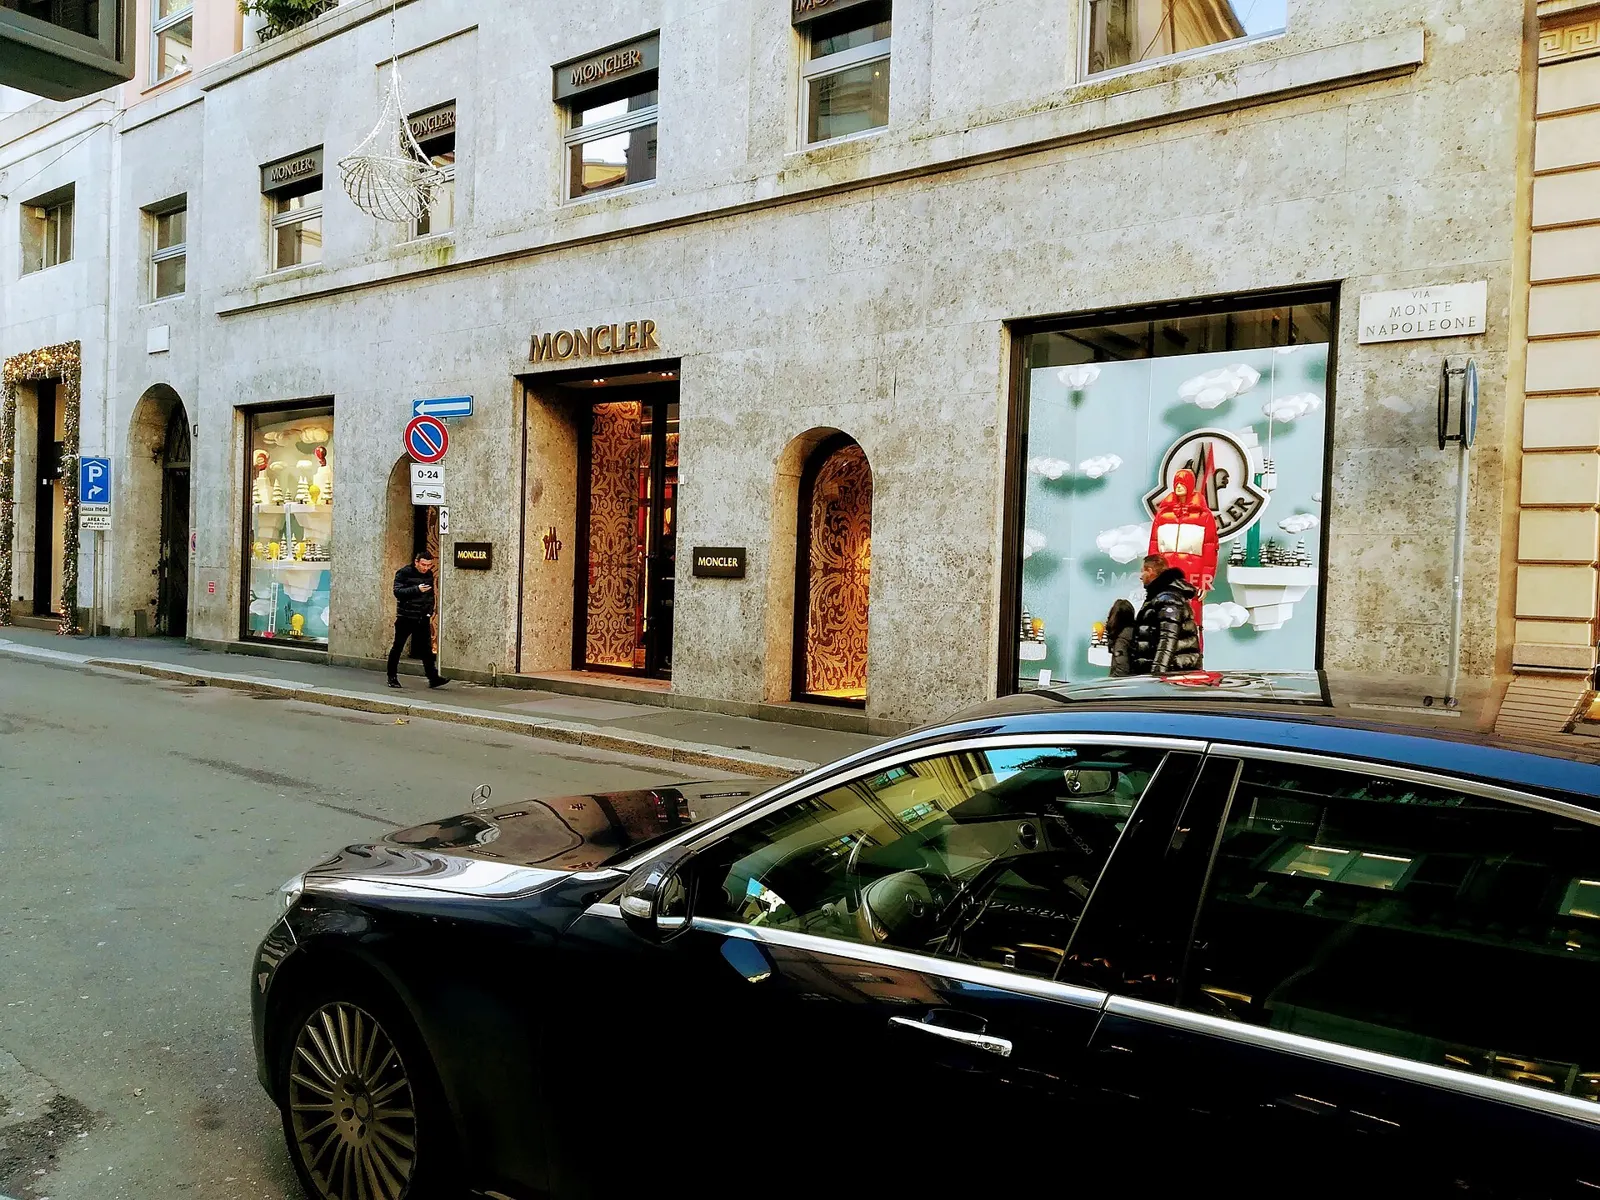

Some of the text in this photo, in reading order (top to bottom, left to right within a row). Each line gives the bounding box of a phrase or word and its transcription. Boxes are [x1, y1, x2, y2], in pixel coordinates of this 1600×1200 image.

[570, 49, 641, 86] MONCLER
[409, 110, 454, 136] ONCLER
[270, 157, 315, 182] MONCLER
[1411, 290, 1431, 299] VIA
[1389, 300, 1453, 318] MONTE
[1365, 316, 1477, 337] NAPOLEONE
[528, 319, 659, 363] MONCLER
[88, 465, 103, 483] P
[417, 470, 439, 479] 0-24
[458, 550, 487, 559] MONCLER
[698, 557, 738, 567] MONCLER
